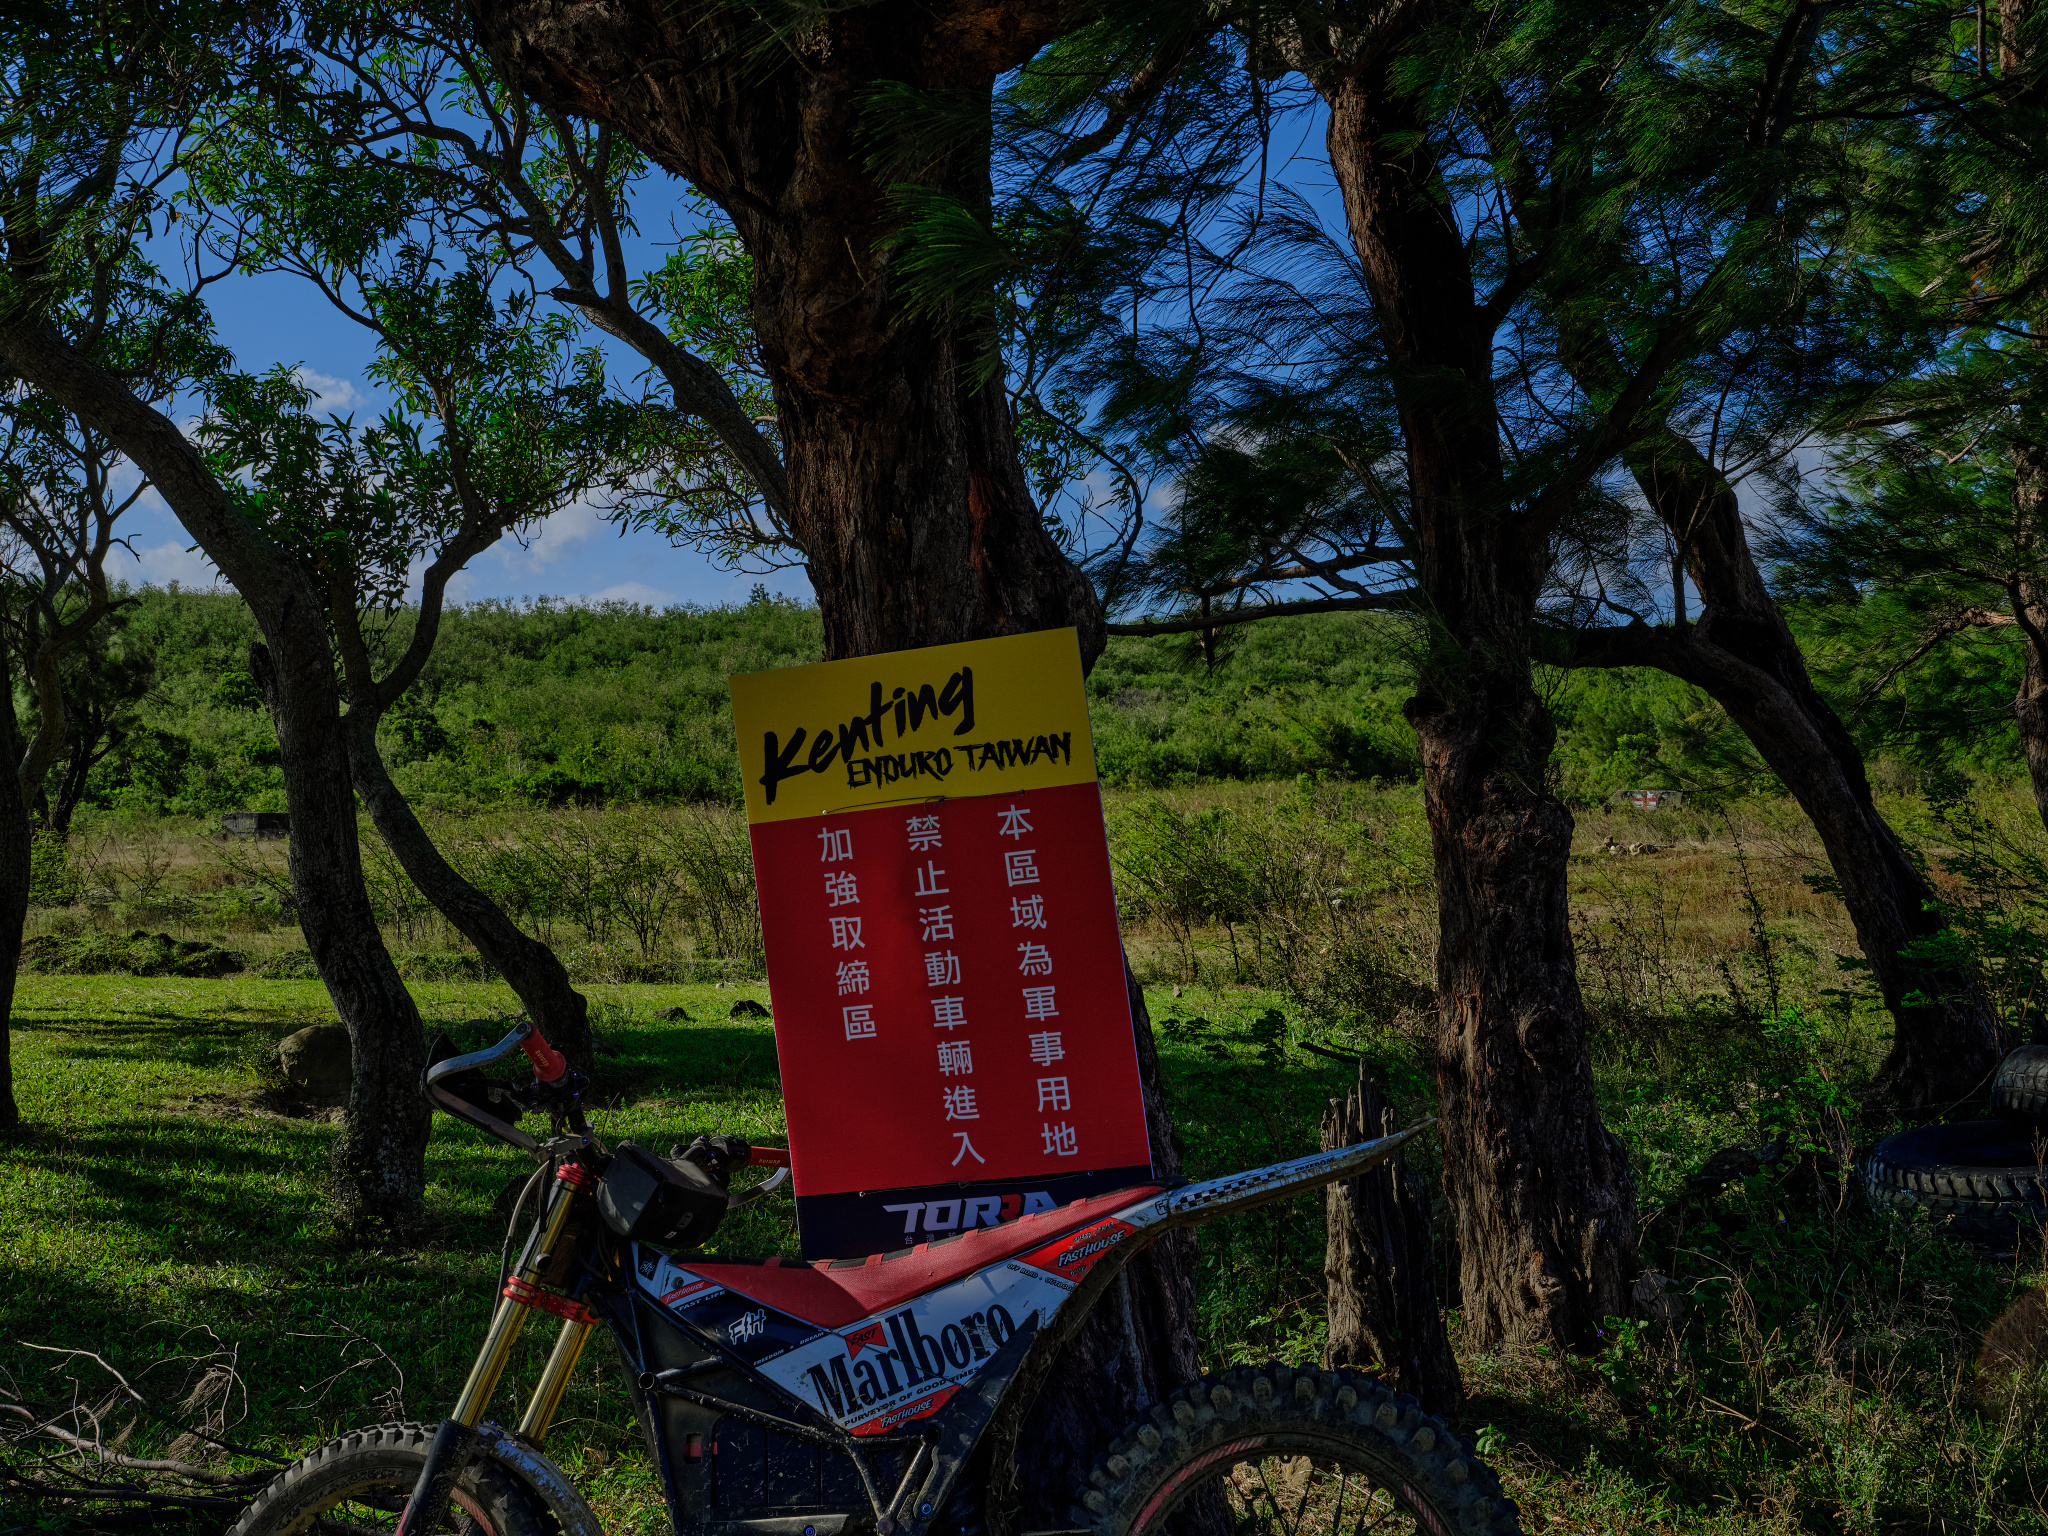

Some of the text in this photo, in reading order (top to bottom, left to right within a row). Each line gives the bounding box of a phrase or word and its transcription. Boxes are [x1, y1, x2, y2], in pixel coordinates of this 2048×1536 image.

[759, 666, 975, 805] Kenting
[847, 732, 1071, 789] ENDURO TAIWAN
[817, 827, 877, 1042] 加強取締區
[905, 814, 986, 1167] 禁止活動車輛進入
[997, 804, 1079, 1157] 本區域為軍事用地
[1058, 1229, 1126, 1267] FASTHOUSE
[678, 1289, 726, 1311] FAST LIFE
[753, 1348, 785, 1367] FREEDOM
[805, 1304, 1016, 1420] Marlboro
[850, 1326, 880, 1346] FAST
[843, 1365, 982, 1427] PURVEYOR OF GOOD TIMES
[880, 1398, 935, 1429] FASTHOUSE
